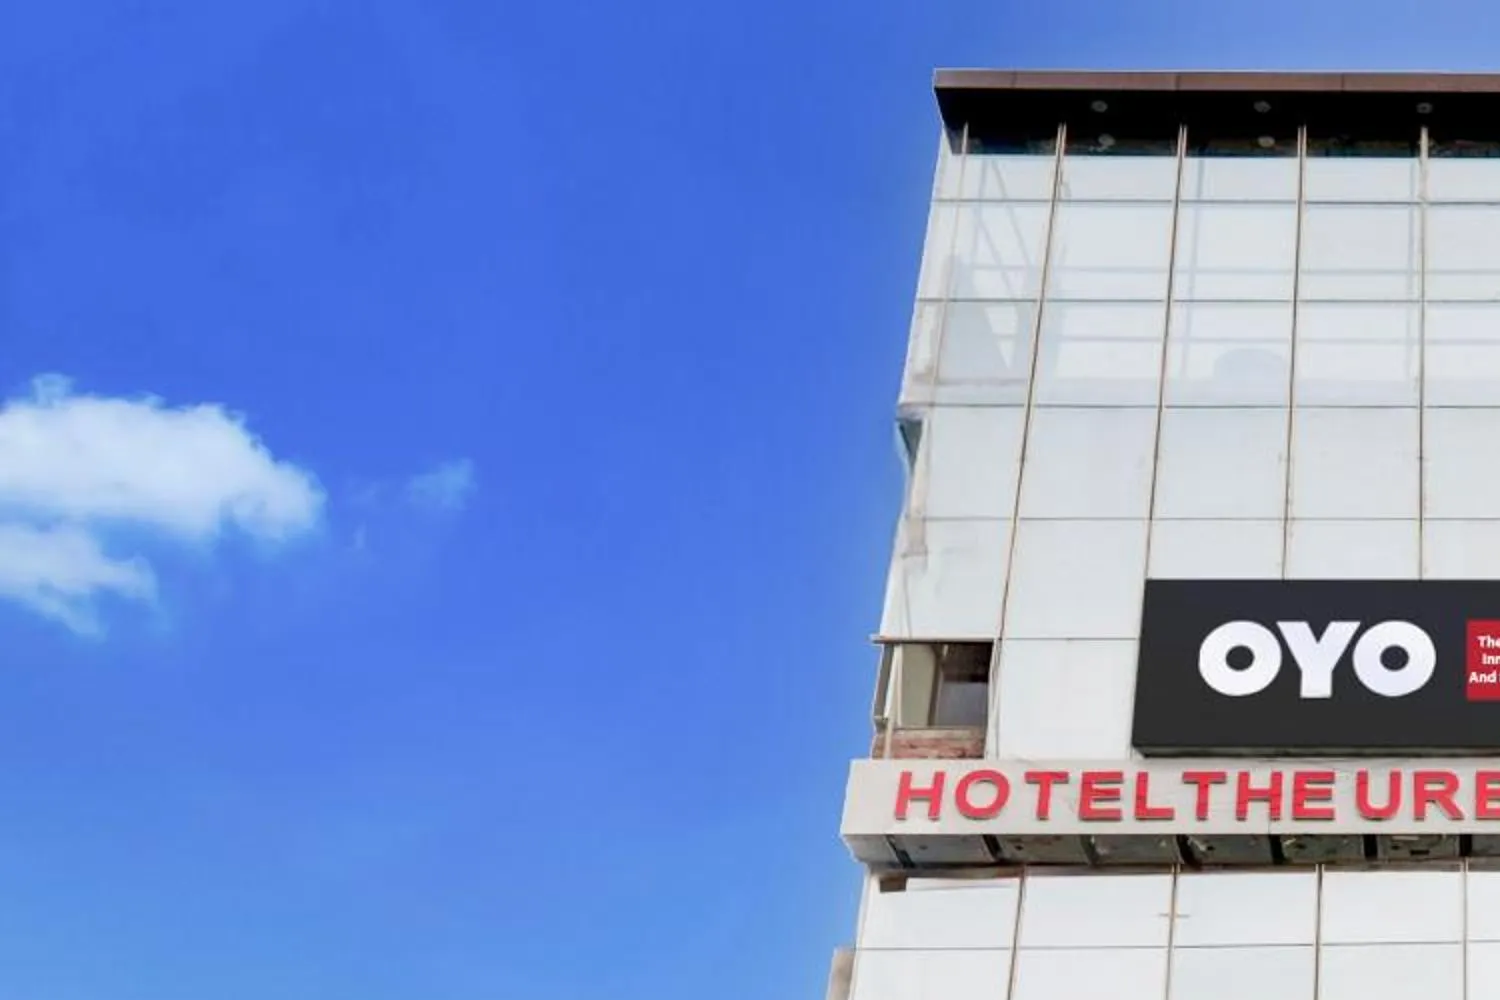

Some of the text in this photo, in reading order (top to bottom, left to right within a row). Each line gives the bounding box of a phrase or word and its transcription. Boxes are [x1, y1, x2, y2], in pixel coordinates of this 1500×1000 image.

[1198, 619, 1437, 699] OYO
[1469, 670, 1497, 684] And
[894, 769, 1175, 822] HOTEL
[1182, 770, 1336, 822] THE
